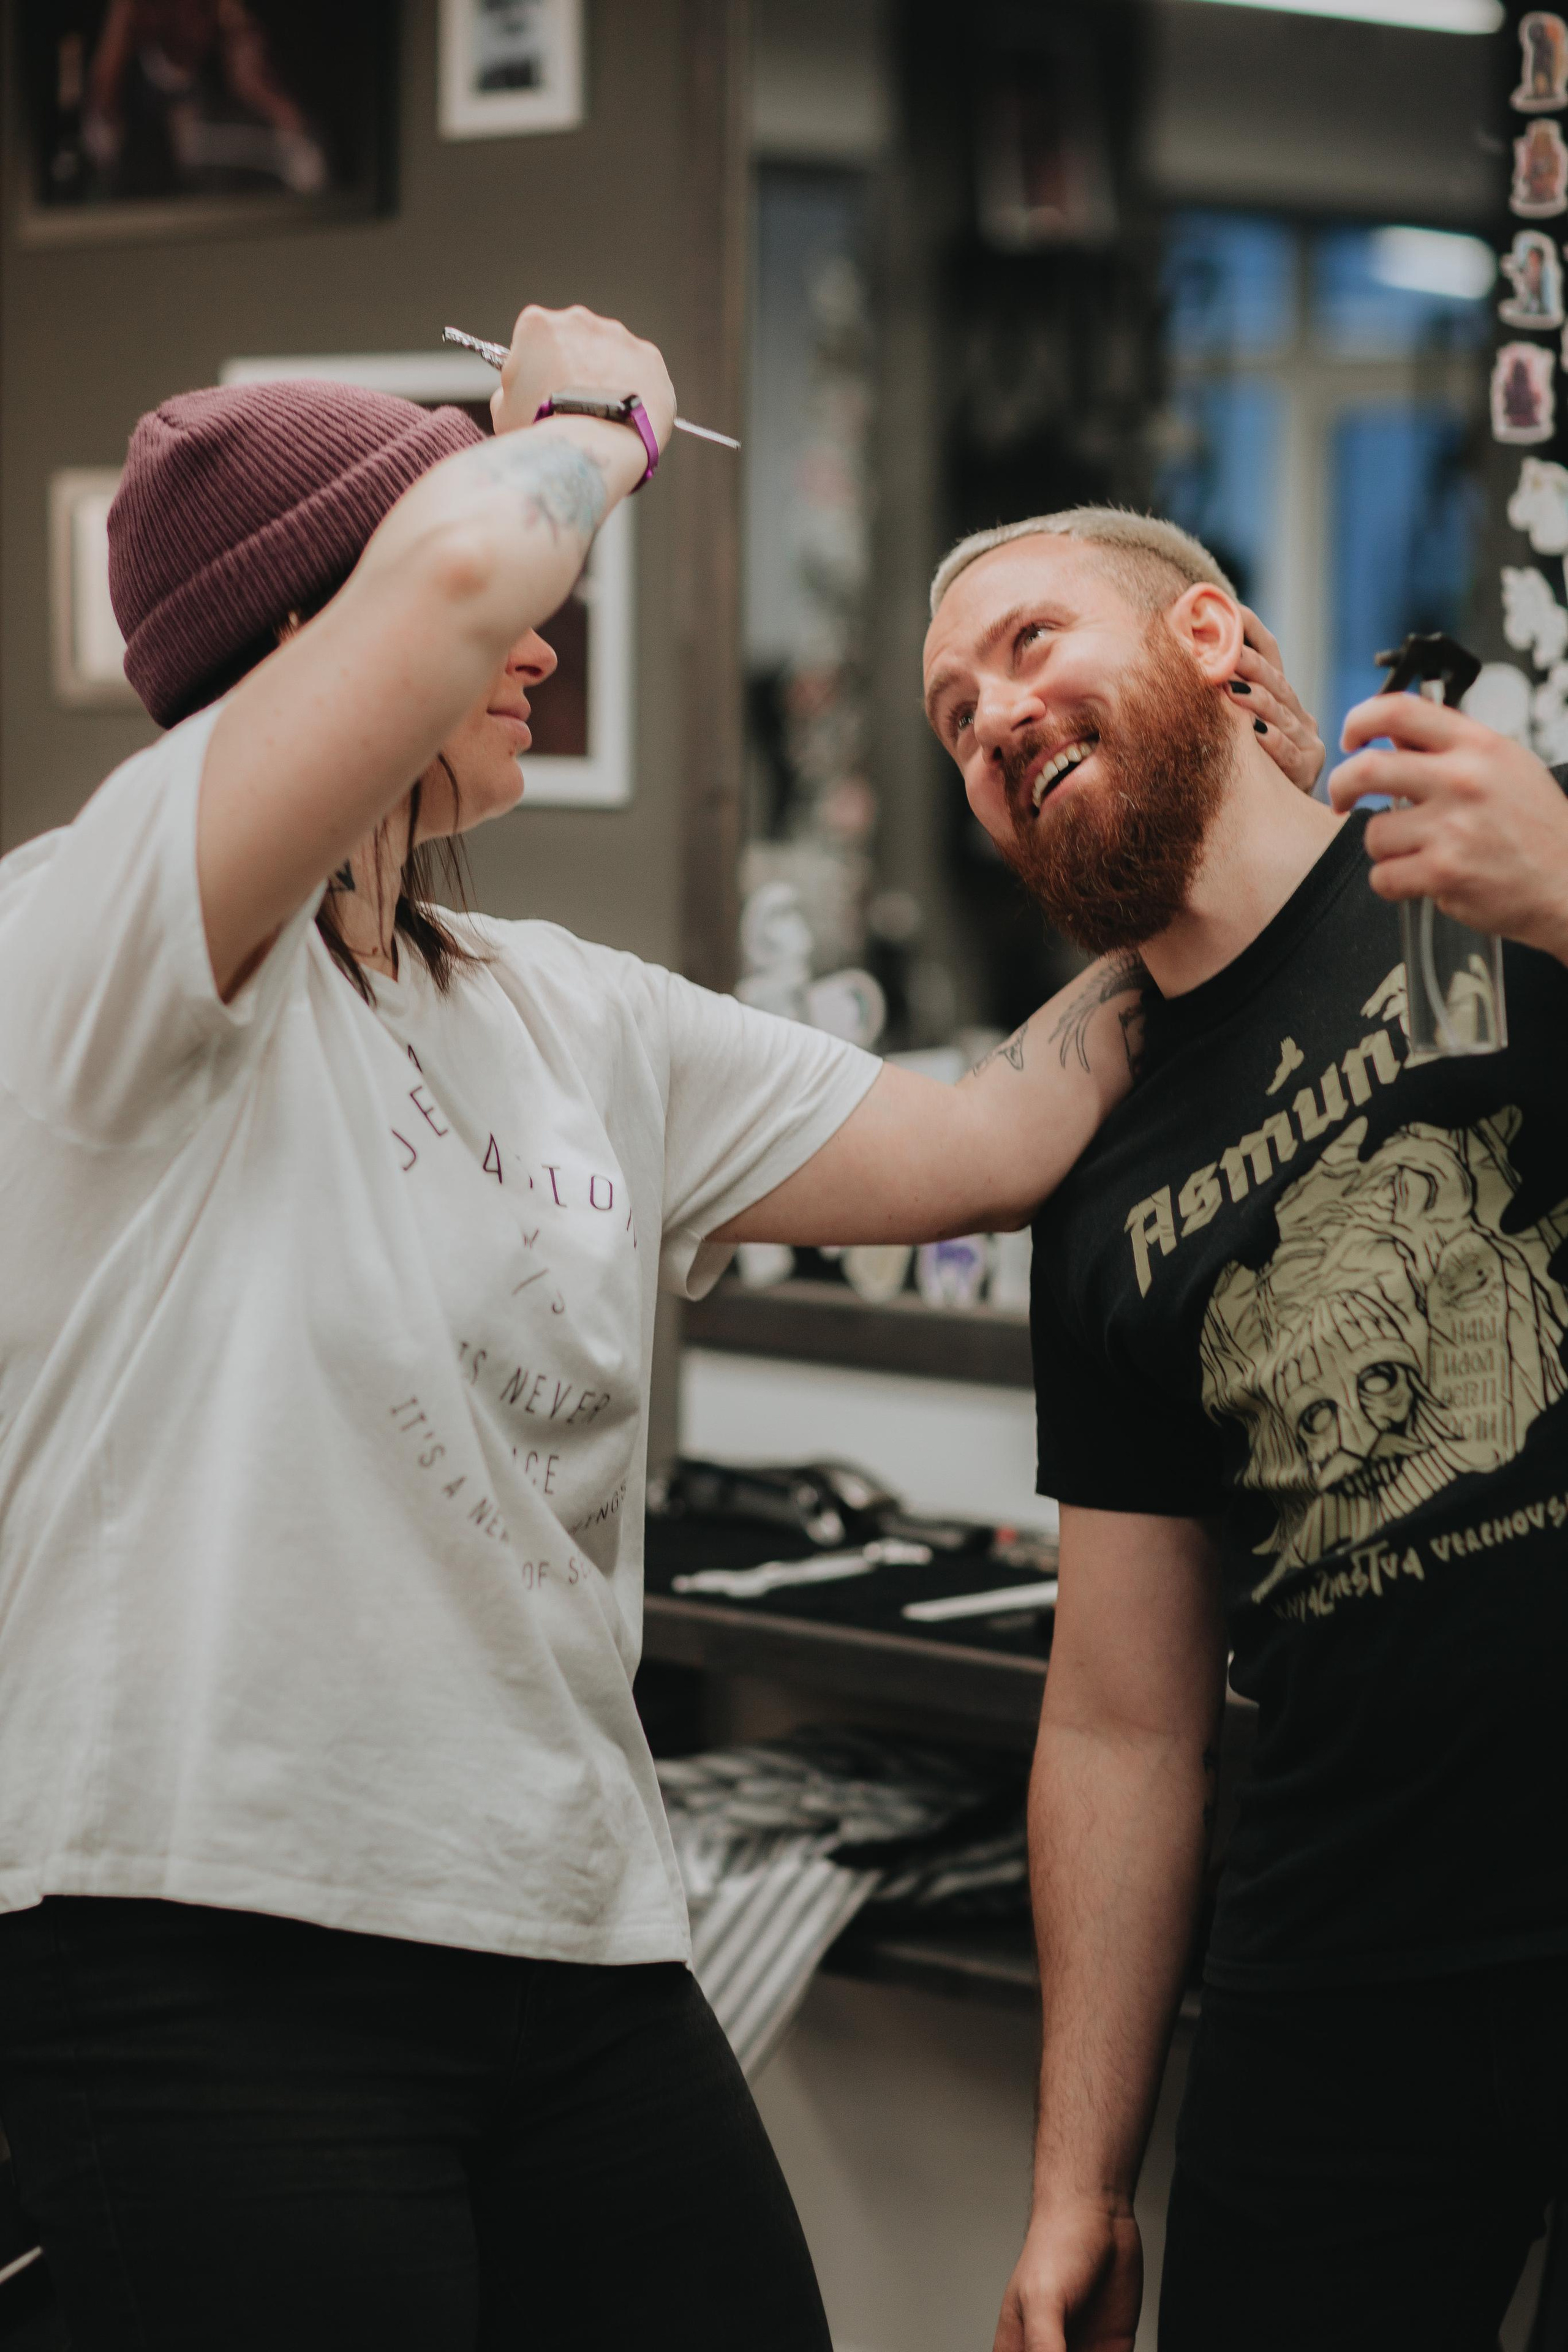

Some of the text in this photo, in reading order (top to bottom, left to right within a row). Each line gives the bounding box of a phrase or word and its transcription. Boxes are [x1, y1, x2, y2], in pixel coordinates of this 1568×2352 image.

[390, 1395, 446, 1468] IT'S
[442, 1476, 467, 1498] A
[1429, 1491, 1568, 1562] VERCHOVS
